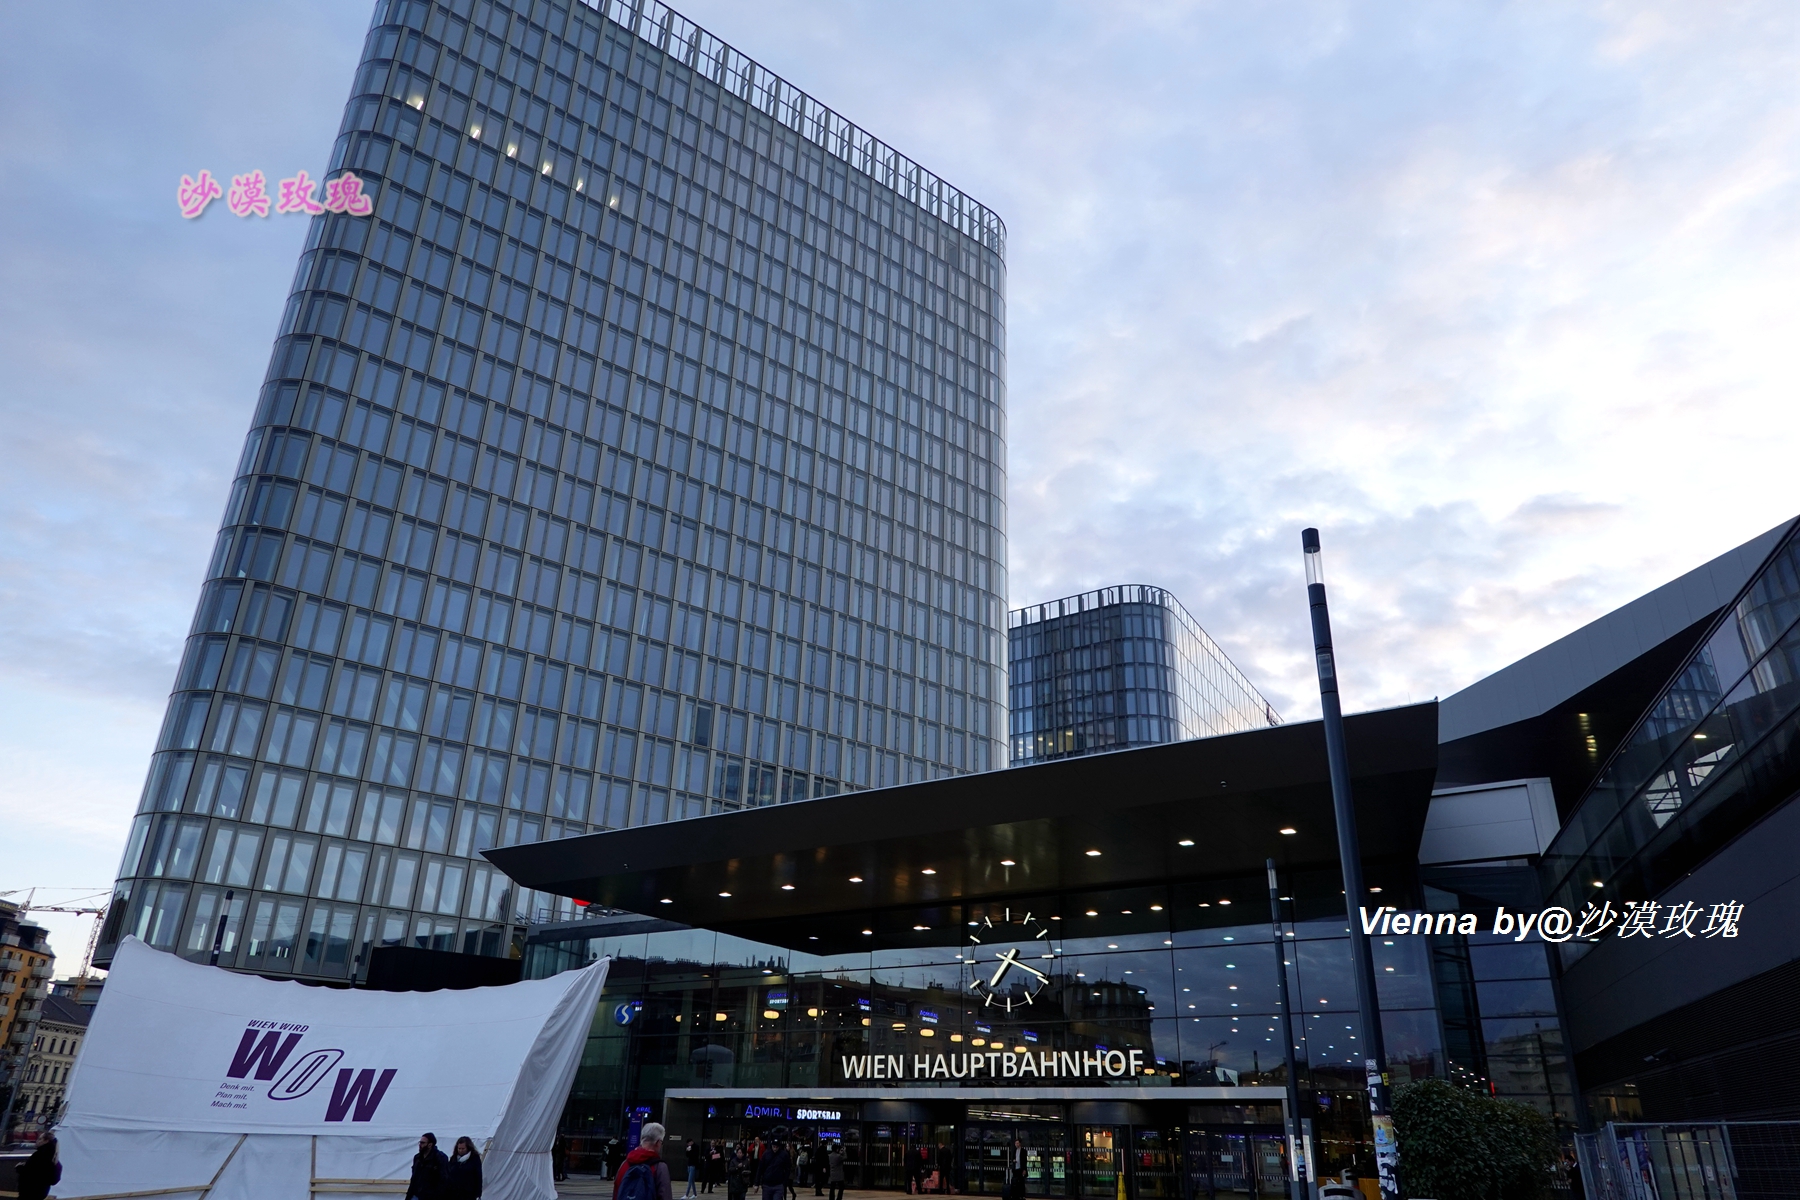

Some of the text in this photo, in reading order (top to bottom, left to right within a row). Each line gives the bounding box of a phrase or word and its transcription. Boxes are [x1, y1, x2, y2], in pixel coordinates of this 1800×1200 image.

[248, 1019, 309, 1033] WIEN WIRD
[842, 1049, 1143, 1079] WIEN HAUPTBAHNHOF
[219, 1082, 255, 1092] Denk mit.
[215, 1091, 248, 1100] Plan mit.
[210, 1100, 248, 1110] Mach mit.
[744, 1104, 842, 1120] ADMIRL SPORTSBAR
